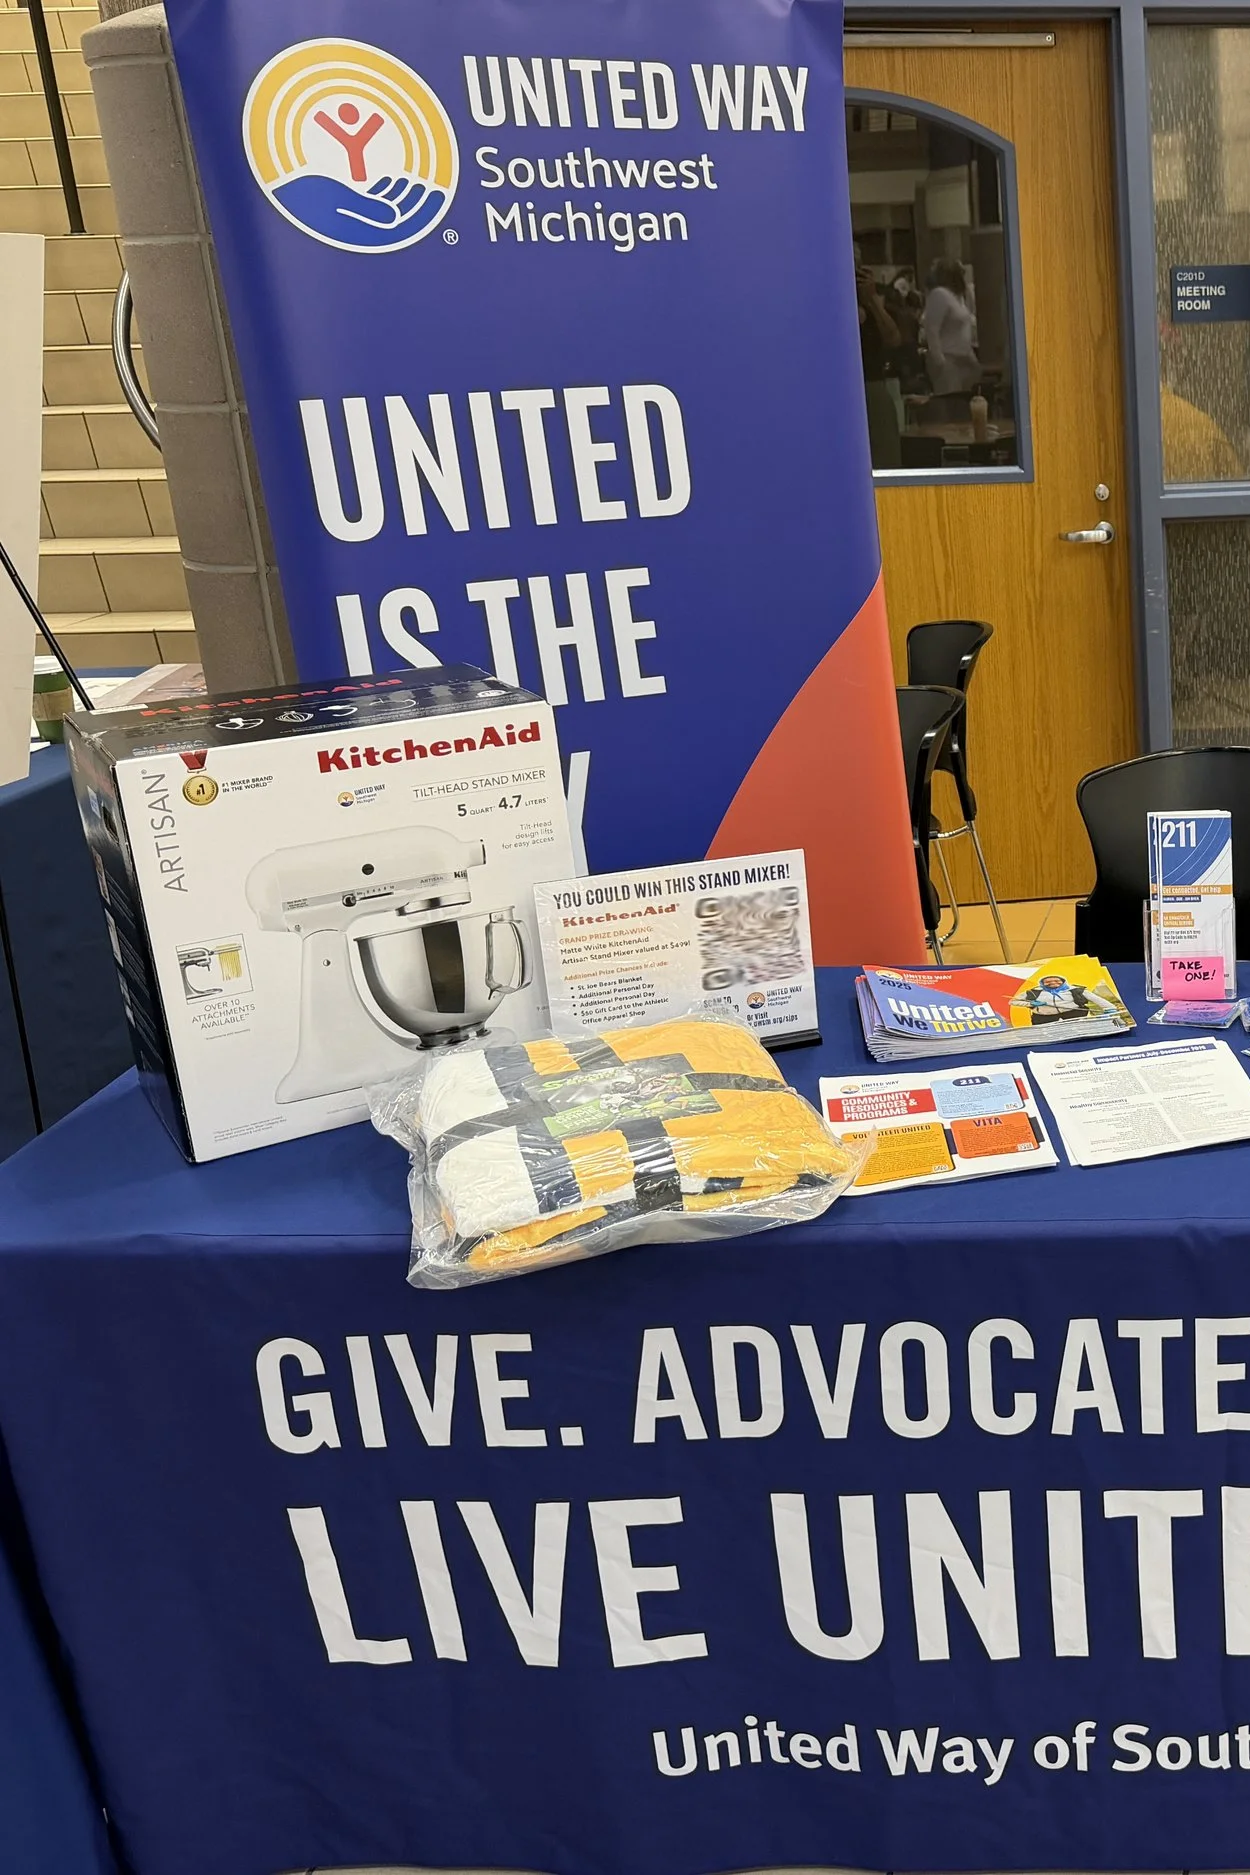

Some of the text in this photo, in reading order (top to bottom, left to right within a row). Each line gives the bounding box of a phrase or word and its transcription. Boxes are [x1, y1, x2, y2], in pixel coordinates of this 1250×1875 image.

[463, 55, 809, 132] UNITED WAY
[474, 146, 718, 190] Southwest
[485, 201, 688, 253] Michigan
[1176, 272, 1205, 281] C201D
[1176, 285, 1226, 297] MEETING
[1177, 300, 1210, 311] ROOM
[299, 384, 691, 543] UNITED
[335, 567, 667, 707] IS THE
[316, 722, 541, 774] KitchenAid
[230, 779, 250, 787] MIXER
[251, 775, 273, 784] BRAND
[413, 769, 546, 799] TILT-HEAD STAND MIXER
[354, 783, 386, 796] UNITED WAY
[457, 803, 467, 817] 5
[498, 795, 522, 811] 4.7
[520, 820, 552, 831] Tilt-Head
[515, 828, 539, 841] design
[1161, 820, 1197, 848] 211
[514, 840, 529, 850] easy
[530, 836, 554, 845] access
[553, 863, 791, 910] YOU COULD WIN THIS STAND MIXER!
[559, 935, 588, 945] GRAND
[589, 931, 612, 940] PRIZE
[562, 956, 589, 965] Artisan
[590, 952, 612, 961] Stand
[613, 948, 634, 957] Mixer
[635, 944, 660, 954] valued
[1169, 961, 1203, 970] TAKE
[564, 971, 598, 982] Additional
[599, 968, 615, 977] Prize
[618, 976, 643, 985] Blanket
[1185, 969, 1216, 982] ONE!
[579, 982, 654, 999] Additional Personal Day
[766, 985, 803, 997] UNITED WAY
[879, 978, 912, 991] 2025
[203, 1001, 228, 1012] OVER
[580, 997, 613, 1008] Additional
[614, 992, 642, 1002] Personal
[595, 1007, 607, 1015] Gift
[608, 1004, 623, 1012] Card
[644, 997, 669, 1006] Athletic
[192, 1004, 256, 1024] ATTACHMENTS
[582, 1009, 646, 1025] Office Apparel Shop
[887, 997, 996, 1021] United
[892, 1013, 1002, 1033] We Thrive
[959, 1078, 982, 1086] 211
[841, 1088, 911, 1107] COMMUNITY
[842, 1098, 918, 1113] RESOURCES &
[843, 1106, 909, 1122] PROGRAMS
[972, 1117, 1003, 1128] VITA
[255, 1331, 585, 1455] GIVE.
[286, 1494, 709, 1668] LIVE
[651, 1715, 860, 1778] United
[875, 1725, 1016, 1786] Way
[1033, 1719, 1098, 1772] of
